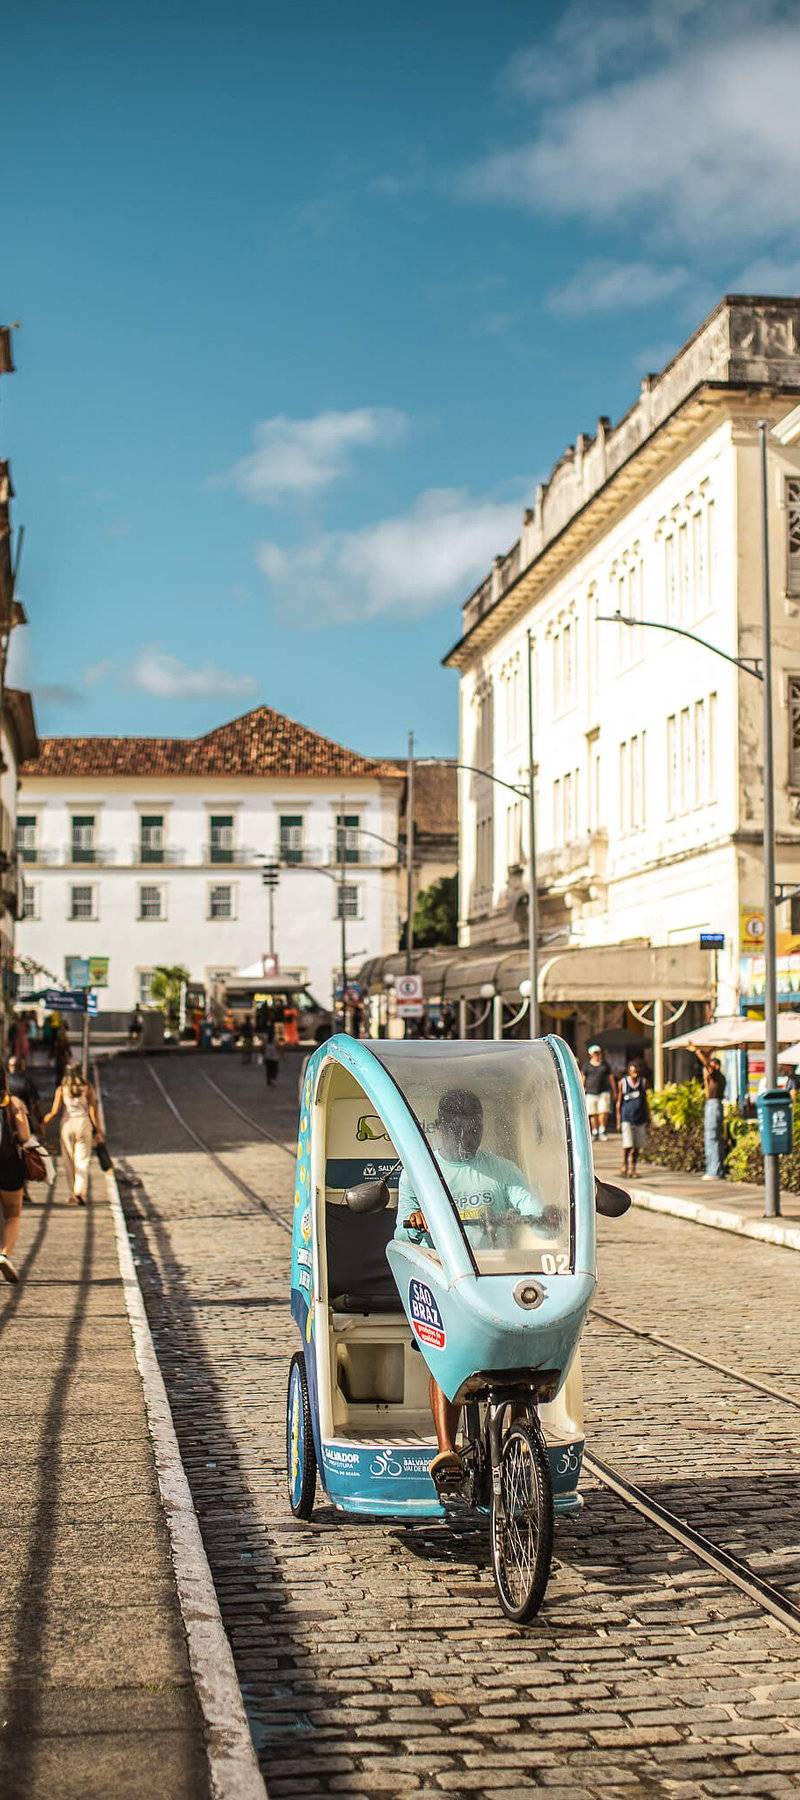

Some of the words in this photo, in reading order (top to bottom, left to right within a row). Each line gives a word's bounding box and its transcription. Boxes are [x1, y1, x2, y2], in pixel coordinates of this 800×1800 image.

[540, 1253, 573, 1275] 02
[413, 1283, 432, 1307] SÃO
[412, 1299, 441, 1327] BRAZ
[325, 1448, 360, 1463] SALVADOR
